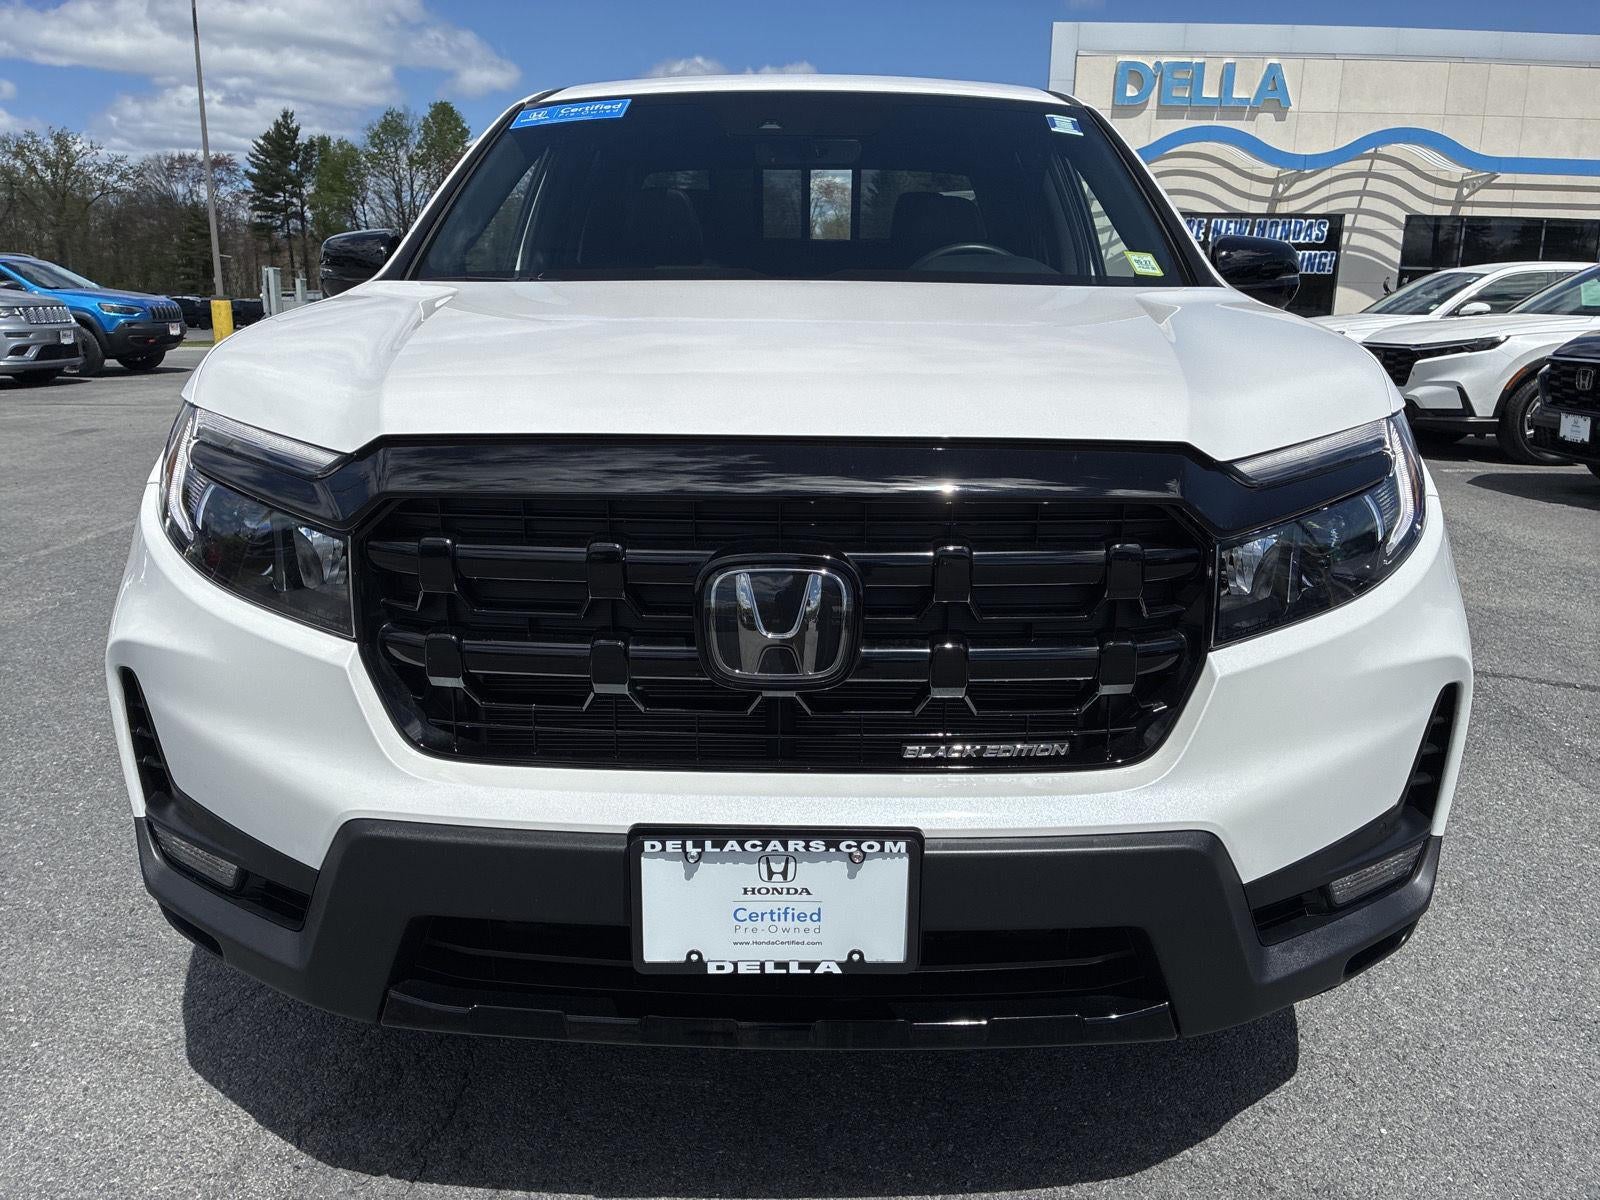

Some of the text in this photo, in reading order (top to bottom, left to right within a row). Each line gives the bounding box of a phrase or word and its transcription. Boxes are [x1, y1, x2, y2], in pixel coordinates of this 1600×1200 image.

[1114, 58, 1292, 108] D'ELLA
[560, 103, 622, 113] Certified
[1209, 218, 1251, 242] NEW
[1254, 218, 1330, 243] HONDAS
[1296, 250, 1336, 275] ING!
[903, 742, 1070, 758] BLACK EDITION
[643, 840, 907, 852] DELLACARS.COM
[742, 887, 813, 896] HONDA
[733, 907, 822, 923] Certified
[734, 924, 821, 935] Pre-Owned
[732, 939, 823, 947] www.HondaCertified.com
[707, 961, 842, 974] DELLA
